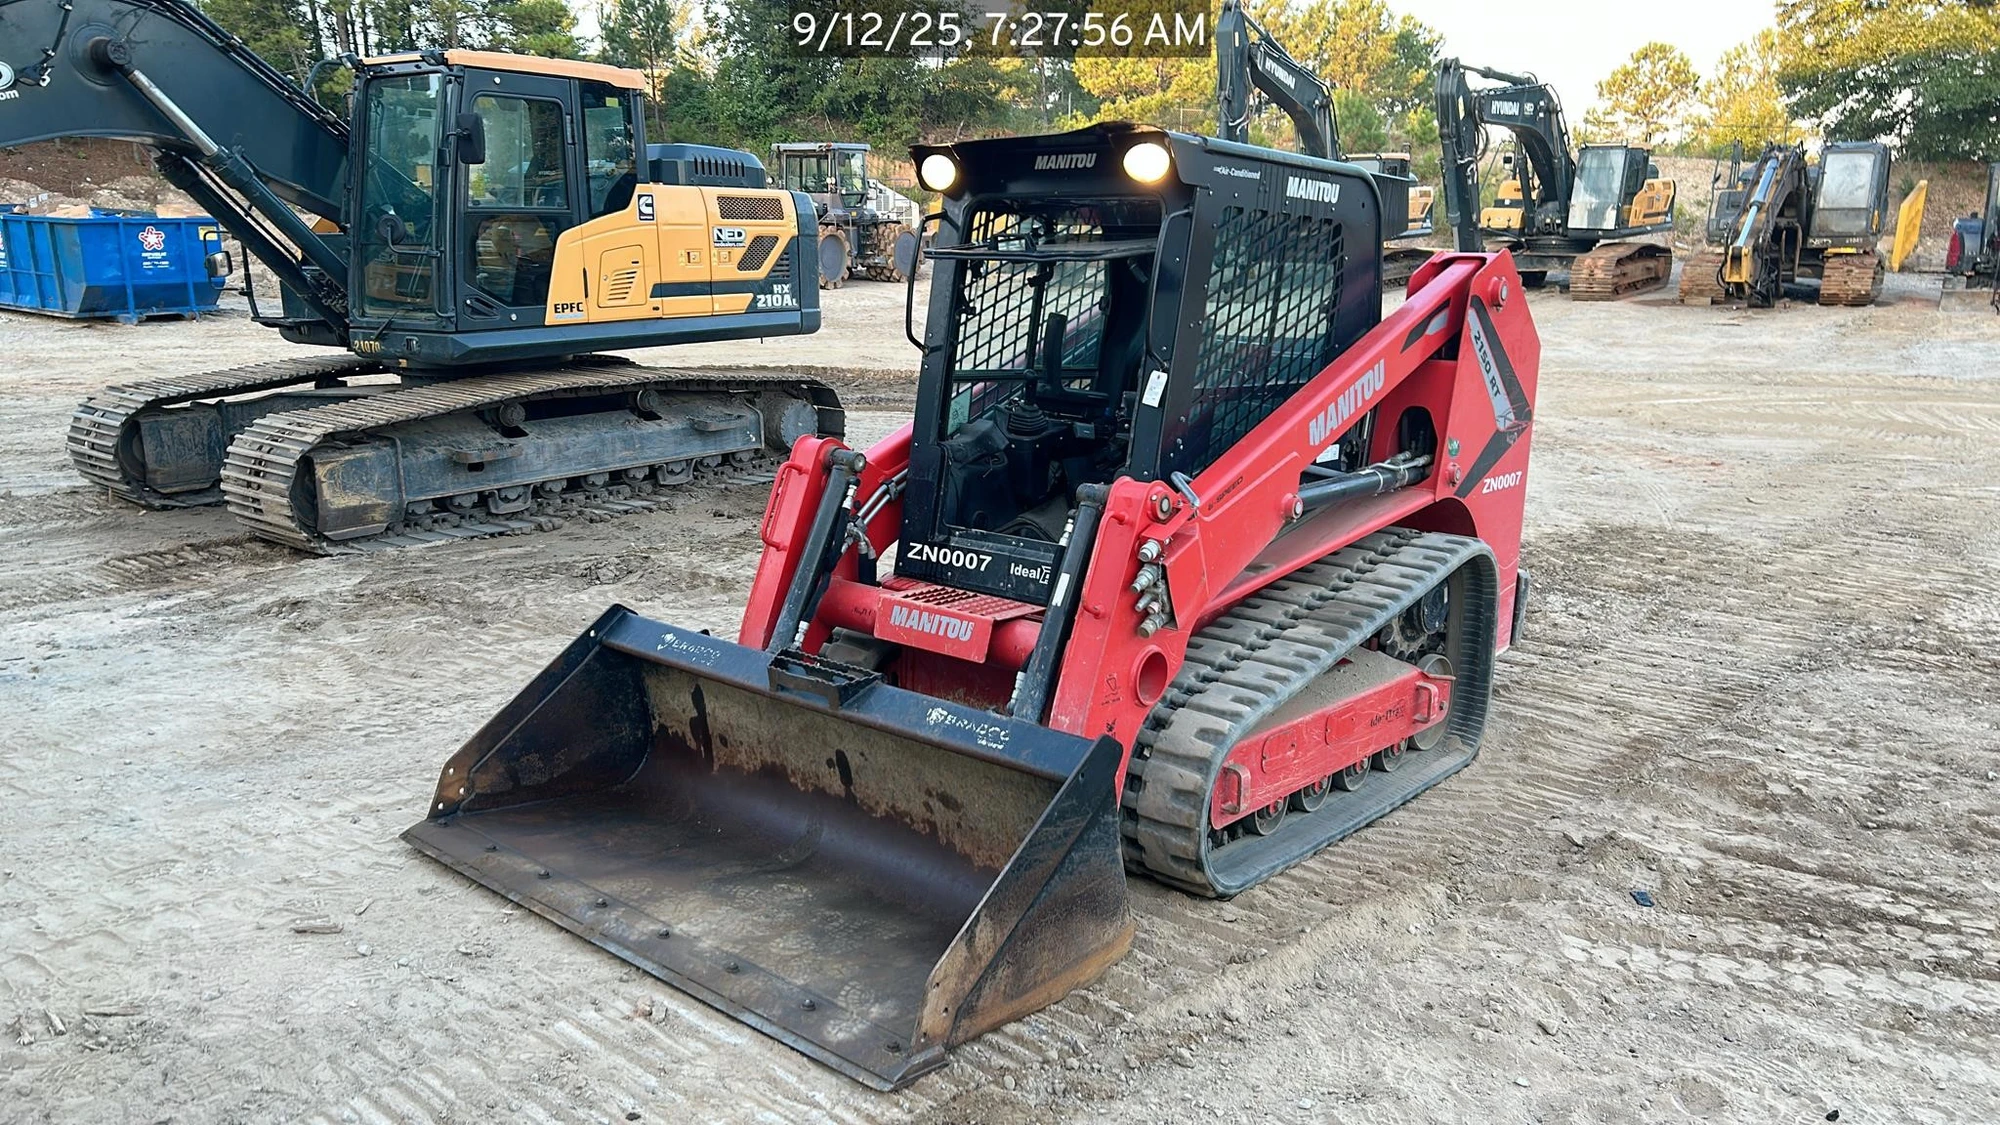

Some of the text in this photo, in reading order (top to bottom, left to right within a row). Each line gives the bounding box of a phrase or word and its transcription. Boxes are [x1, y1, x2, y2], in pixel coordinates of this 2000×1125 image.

[1491, 100, 1520, 116] HYUNDAI
[1034, 153, 1097, 170] MANITOU
[1286, 176, 1340, 204] MANITOU
[713, 228, 745, 242] NED
[773, 284, 791, 294] HX
[554, 302, 584, 313] EPFC
[1473, 331, 1501, 398] 2150 RT
[1309, 358, 1385, 447] MANITOU
[1482, 471, 1522, 494] ZN0007
[907, 542, 993, 572] ZN0007
[890, 605, 975, 642] MANITOU
